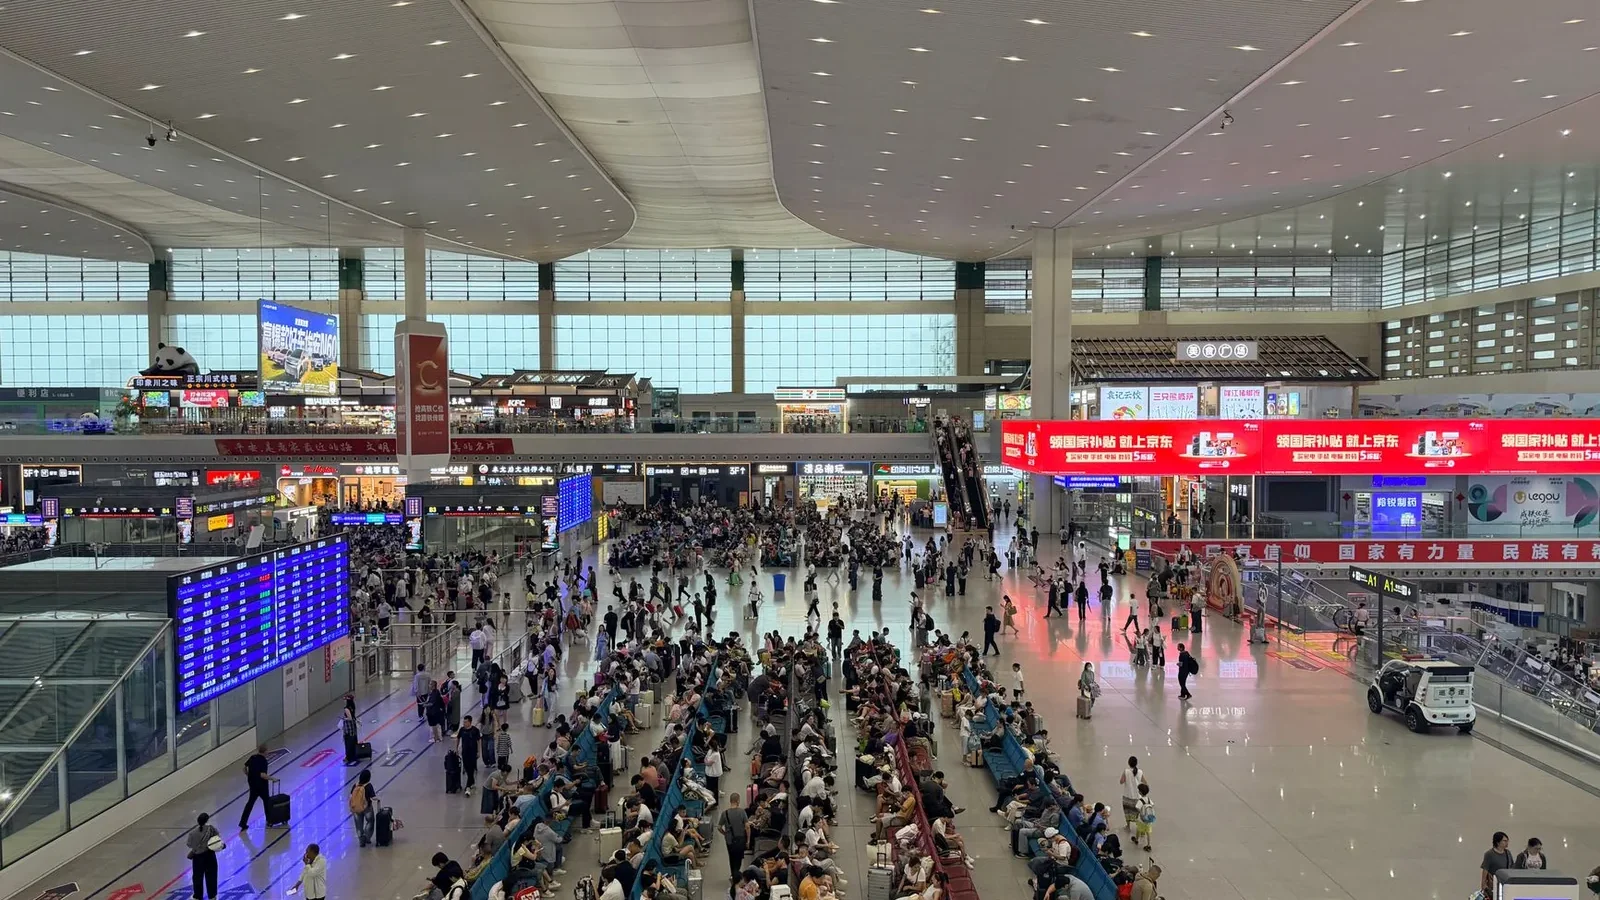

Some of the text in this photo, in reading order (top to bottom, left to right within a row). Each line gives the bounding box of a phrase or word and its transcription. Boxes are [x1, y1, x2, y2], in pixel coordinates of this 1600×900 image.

[1187, 344, 1248, 358] 美食广场
[187, 374, 238, 383] 正宗川式快餐
[16, 388, 48, 398] 便利店
[1106, 390, 1142, 400] 袁记云饺
[1050, 435, 1172, 448] 领国家补贴 就上京东
[1276, 434, 1399, 448] 领国家补贴 就上京东
[1502, 434, 1600, 447] 领国家补贴 就上
[24, 469, 33, 477] 3F
[364, 466, 400, 474] 桃李面包
[730, 467, 740, 475] 3F
[890, 466, 930, 474] 印象川之味
[1377, 497, 1417, 508] 羚锐制药
[1180, 544, 1311, 560] 民有信仰
[1338, 544, 1474, 560] 国家有力量
[1368, 574, 1377, 587] A1
[1384, 579, 1394, 592] A1
